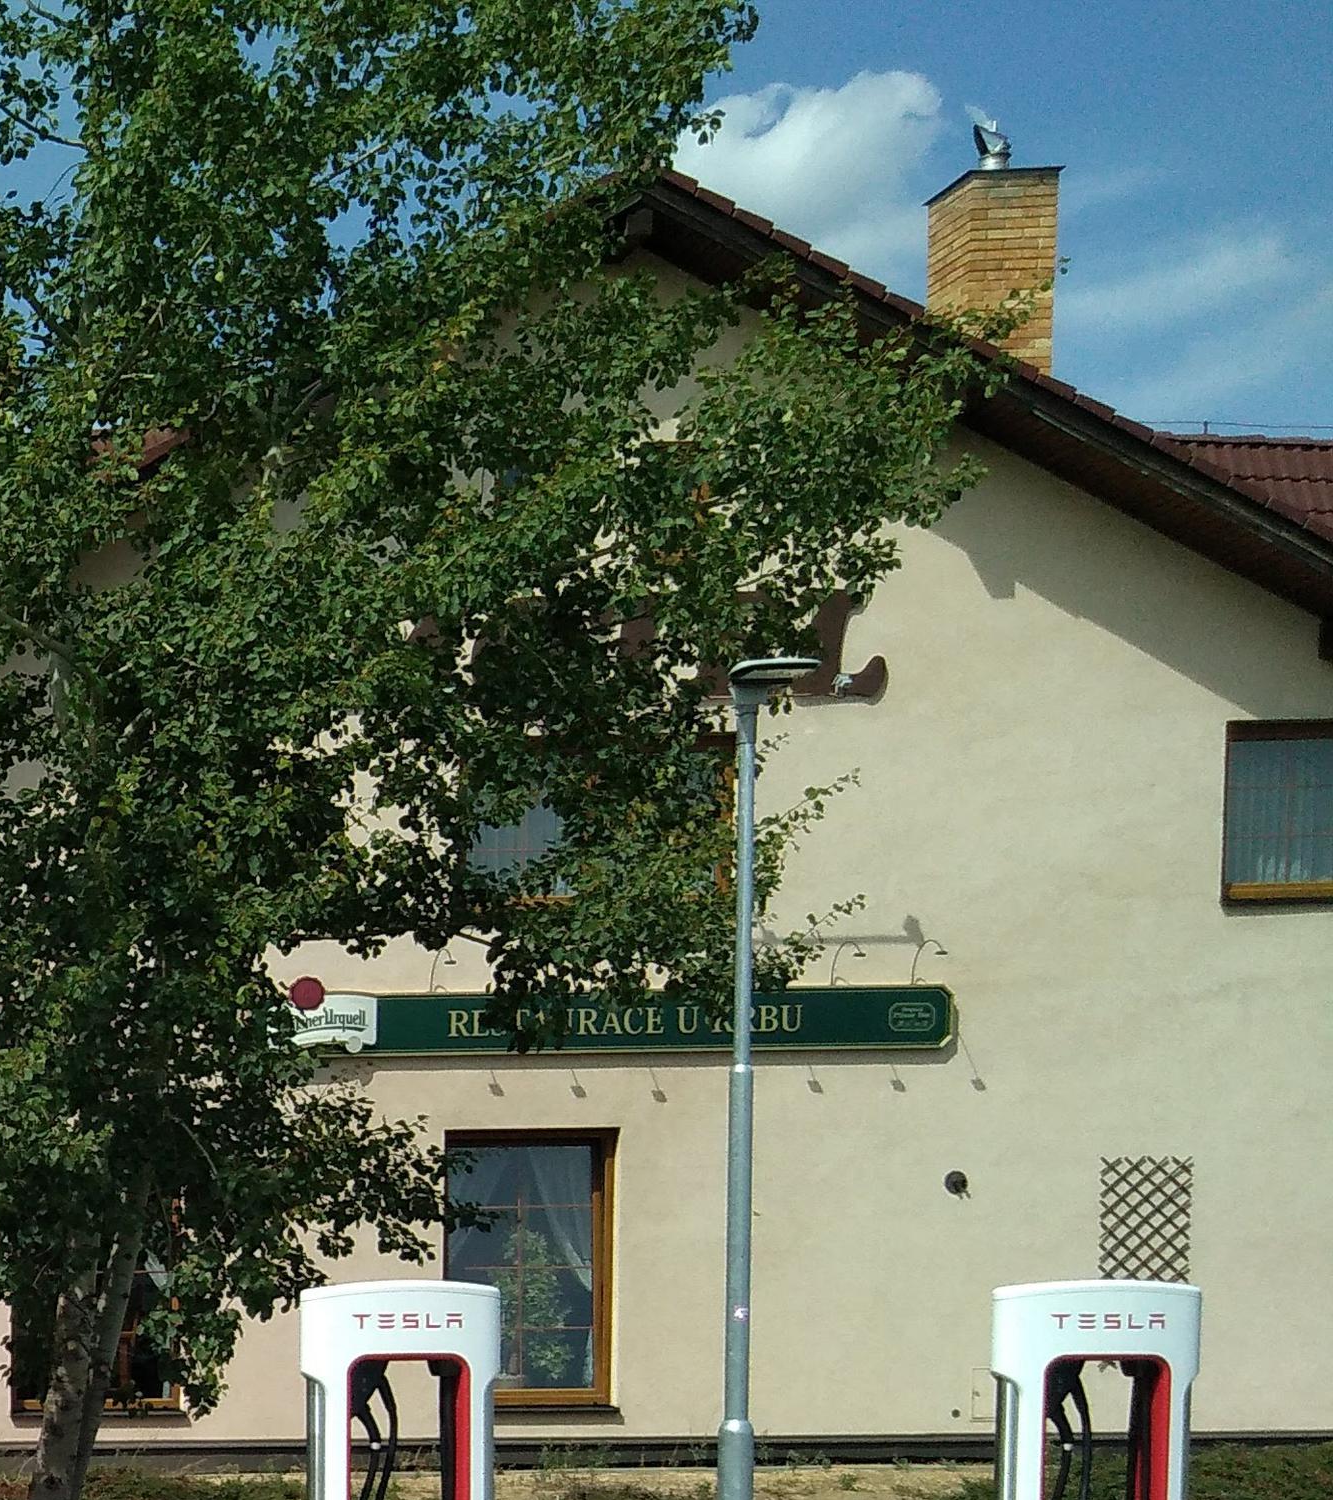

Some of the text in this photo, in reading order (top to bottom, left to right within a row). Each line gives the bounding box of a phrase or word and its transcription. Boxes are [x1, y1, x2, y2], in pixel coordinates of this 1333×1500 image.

[324, 1007, 367, 1032] Urquell
[677, 1005, 700, 1034] U
[352, 1313, 462, 1329] TESLA
[1050, 1313, 1165, 1329] TESLA
